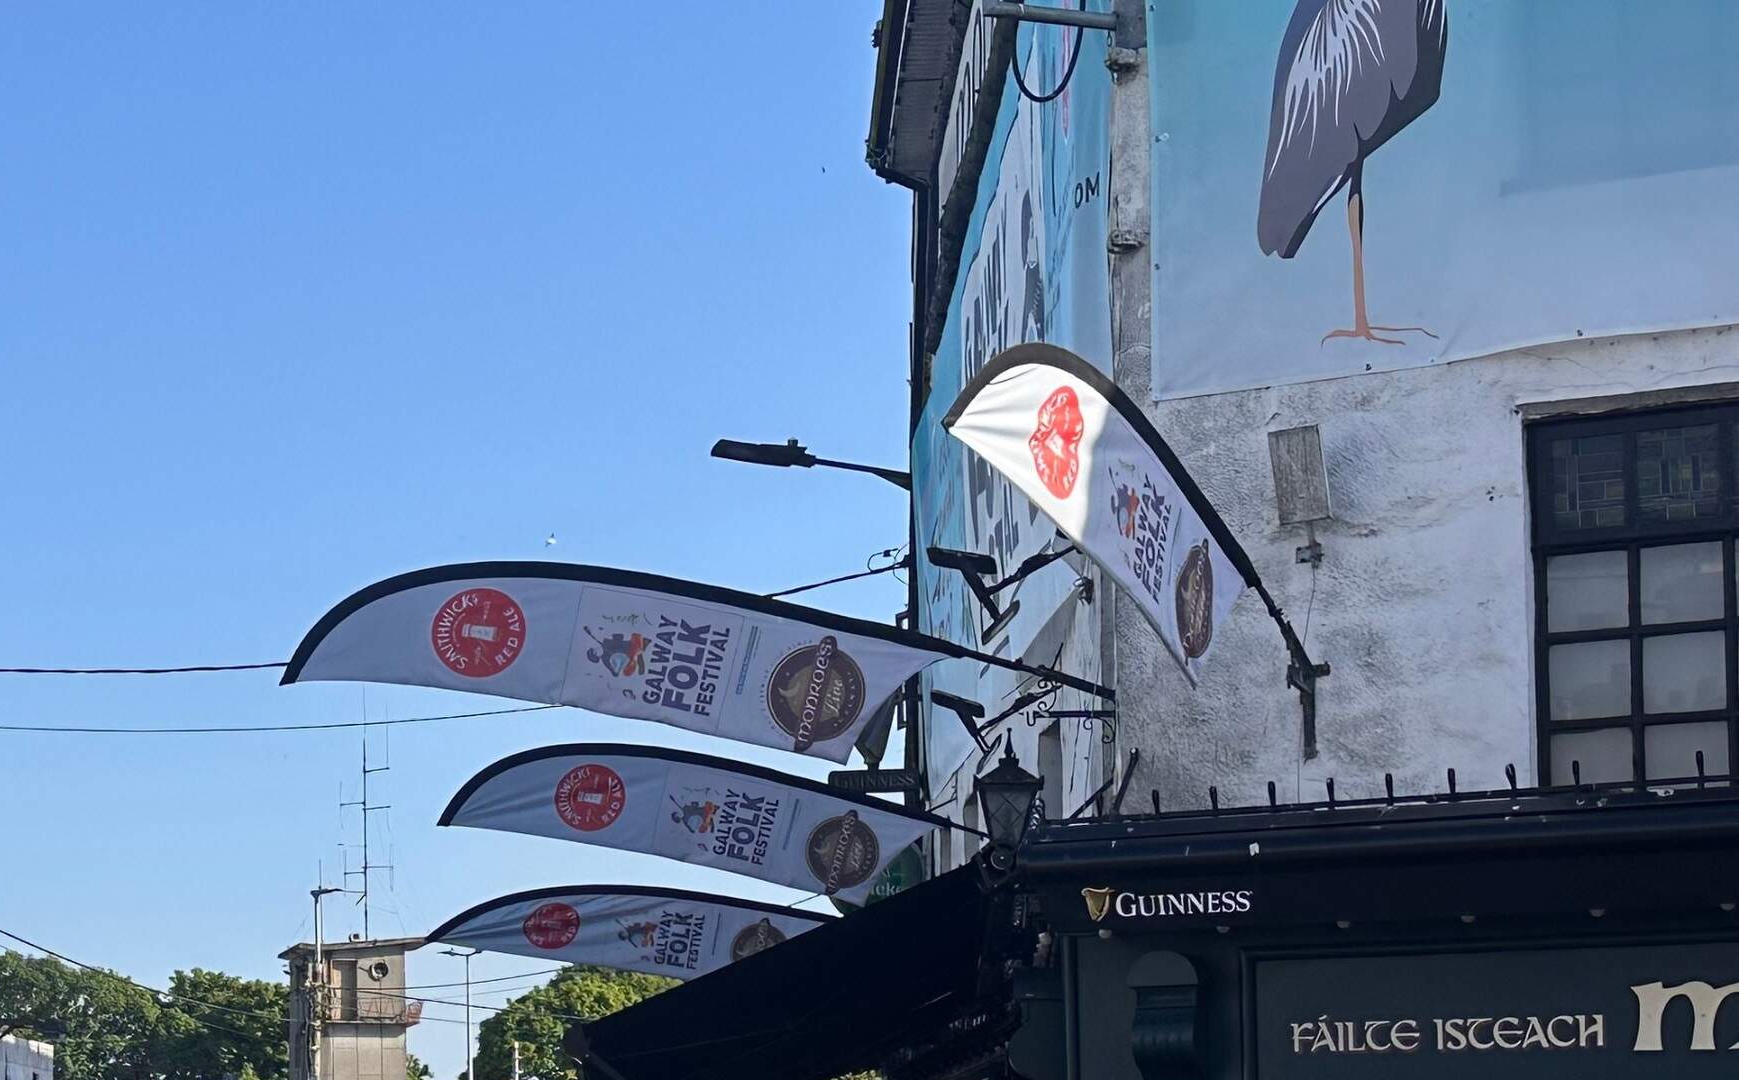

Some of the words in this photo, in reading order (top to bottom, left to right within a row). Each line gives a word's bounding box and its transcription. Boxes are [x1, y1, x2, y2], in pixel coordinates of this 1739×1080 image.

[1143, 483, 1165, 594] FOLK
[494, 637, 519, 666] RED
[503, 607, 521, 631] ALE
[642, 615, 679, 704] GALWAY
[662, 618, 711, 712] FOLK
[693, 627, 730, 716] FESTIVAL
[712, 788, 740, 855] GALWAY
[727, 792, 765, 861] FOLK
[751, 799, 779, 865] FESTIVAL
[1115, 891, 1252, 917] GUINNESS
[666, 912, 693, 968] FOLK
[1291, 1014, 1421, 1053] FÁILTE
[1434, 1013, 1605, 1051] ISTEACH
